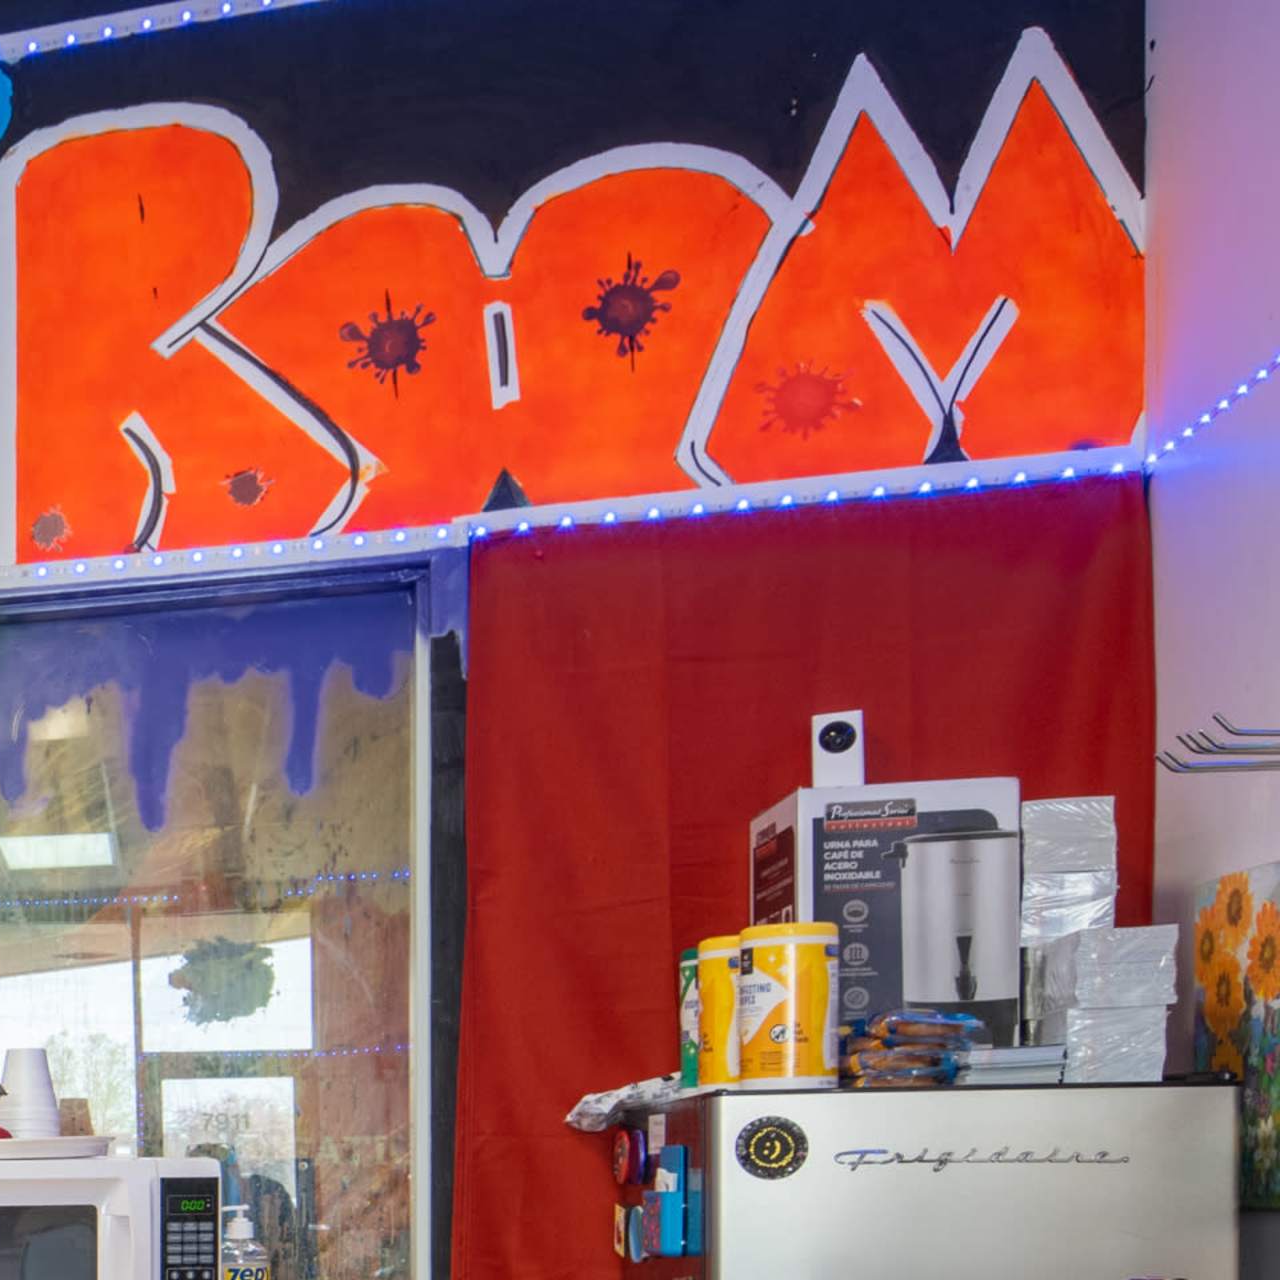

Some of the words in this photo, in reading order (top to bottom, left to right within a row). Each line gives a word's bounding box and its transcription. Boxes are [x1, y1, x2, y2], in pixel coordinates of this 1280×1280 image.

[823, 840, 852, 850] URNA
[852, 838, 879, 849] PARA
[823, 850, 849, 860] CAFÉ
[850, 850, 864, 859] DE
[823, 861, 858, 871] ACERO
[823, 870, 881, 881] INOXIDABLE
[202, 1112, 251, 1131] 7911
[833, 1146, 1130, 1172] Frigidaire
